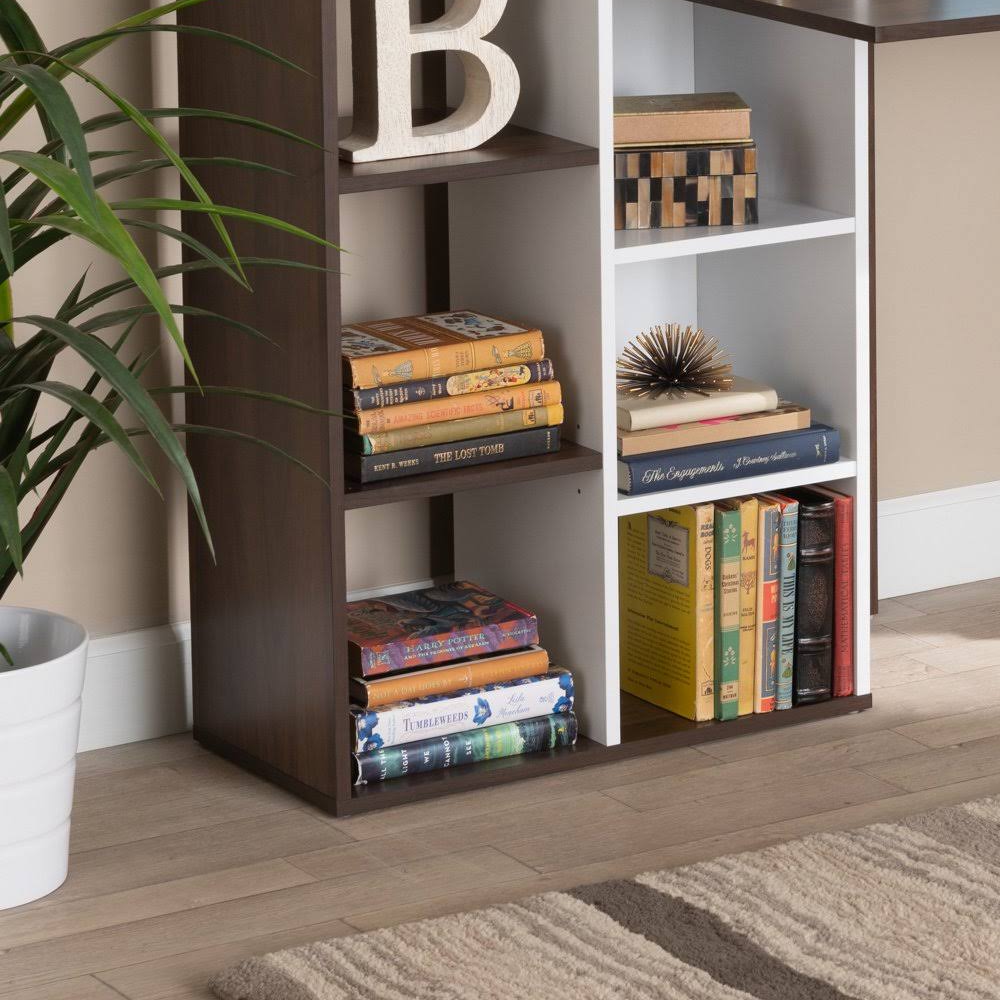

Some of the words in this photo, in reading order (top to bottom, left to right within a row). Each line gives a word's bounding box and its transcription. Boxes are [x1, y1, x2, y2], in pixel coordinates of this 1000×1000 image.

[433, 450, 453, 464] THE
[454, 446, 478, 461] LOST
[478, 443, 505, 457] TOMB
[373, 462, 389, 472] KENT
[641, 467, 665, 484] The
[665, 460, 724, 481] Engagements
[704, 546, 712, 571] DOGS
[782, 601, 795, 612] IS
[406, 640, 444, 654] HARRY
[447, 632, 487, 646] POTTER
[402, 710, 470, 732] TUMBLEWEEDS
[378, 749, 387, 765] THE
[423, 751, 431, 764] WE
[441, 736, 451, 768] CANNOT
[465, 739, 473, 756] SEE
[400, 749, 410, 774] LIGHT
